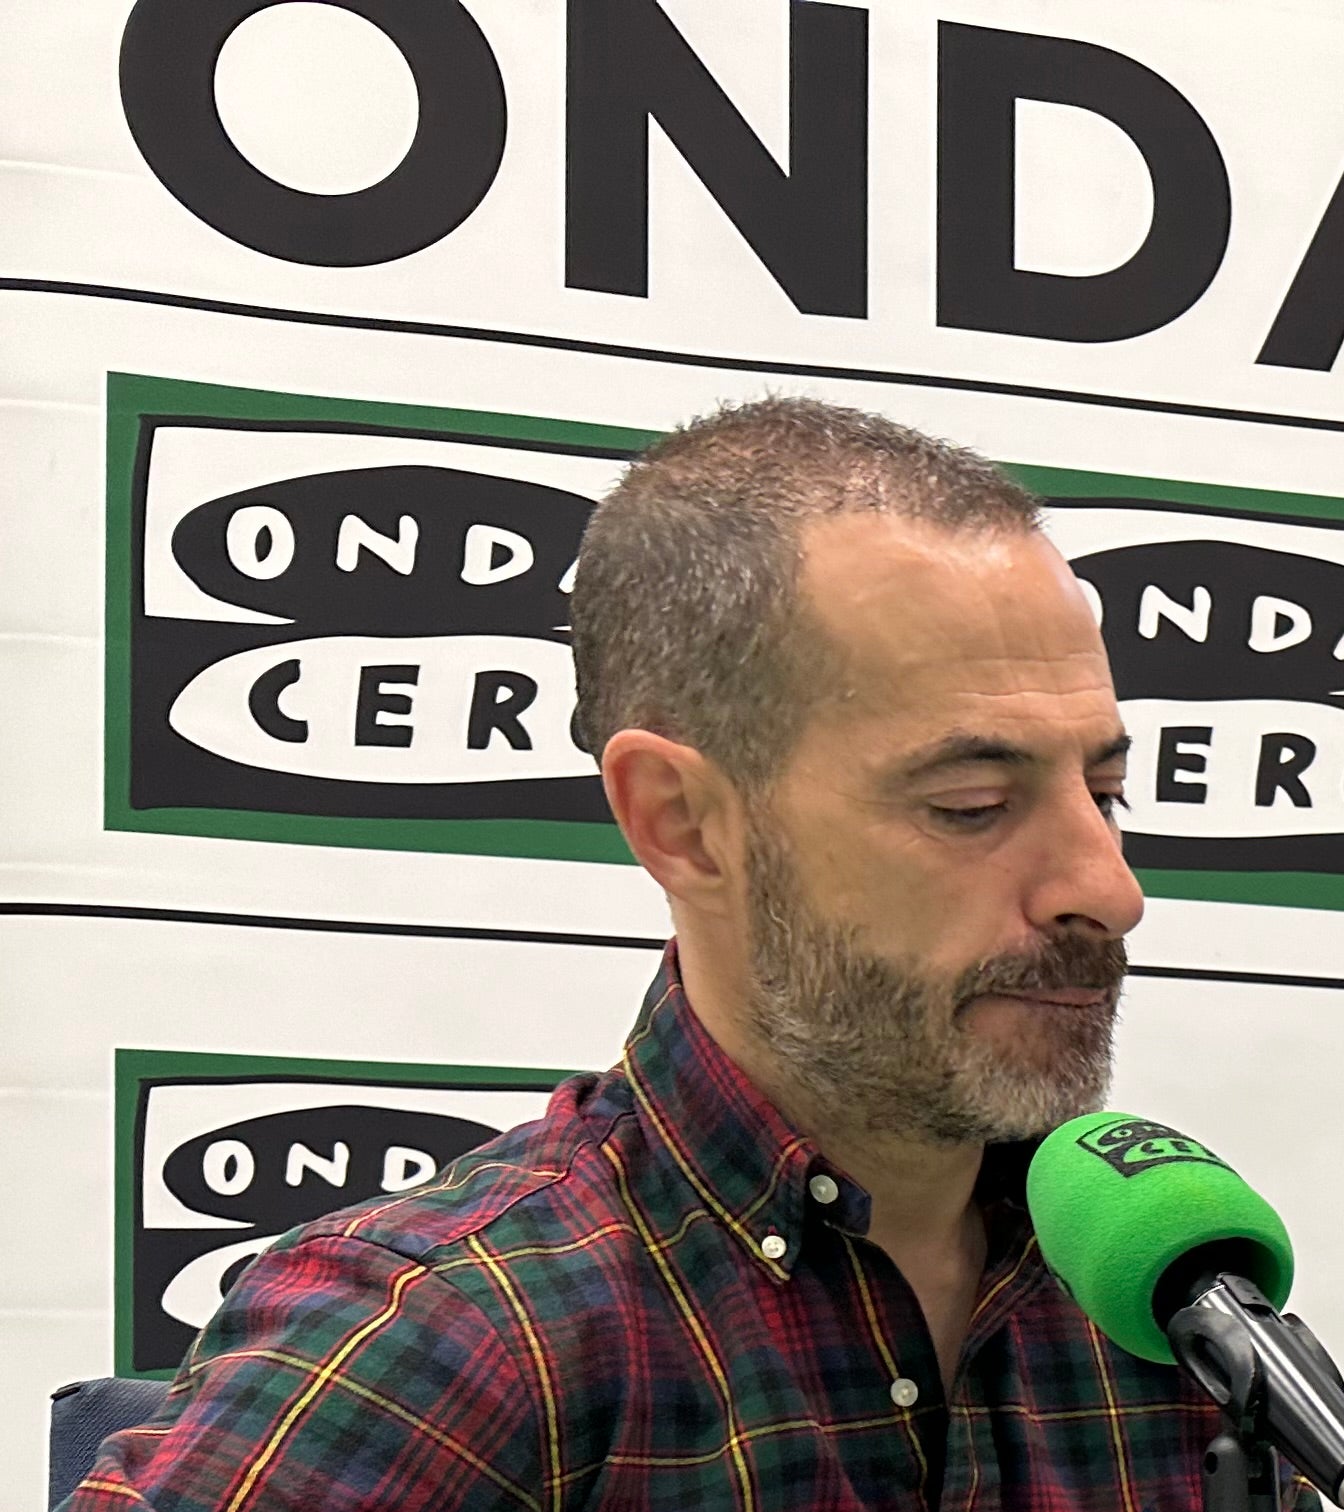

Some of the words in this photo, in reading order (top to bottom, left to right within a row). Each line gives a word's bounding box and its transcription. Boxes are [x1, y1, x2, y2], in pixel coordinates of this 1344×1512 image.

[226, 505, 580, 594] OND
[248, 659, 592, 754] CER
[203, 1140, 436, 1195] OND
